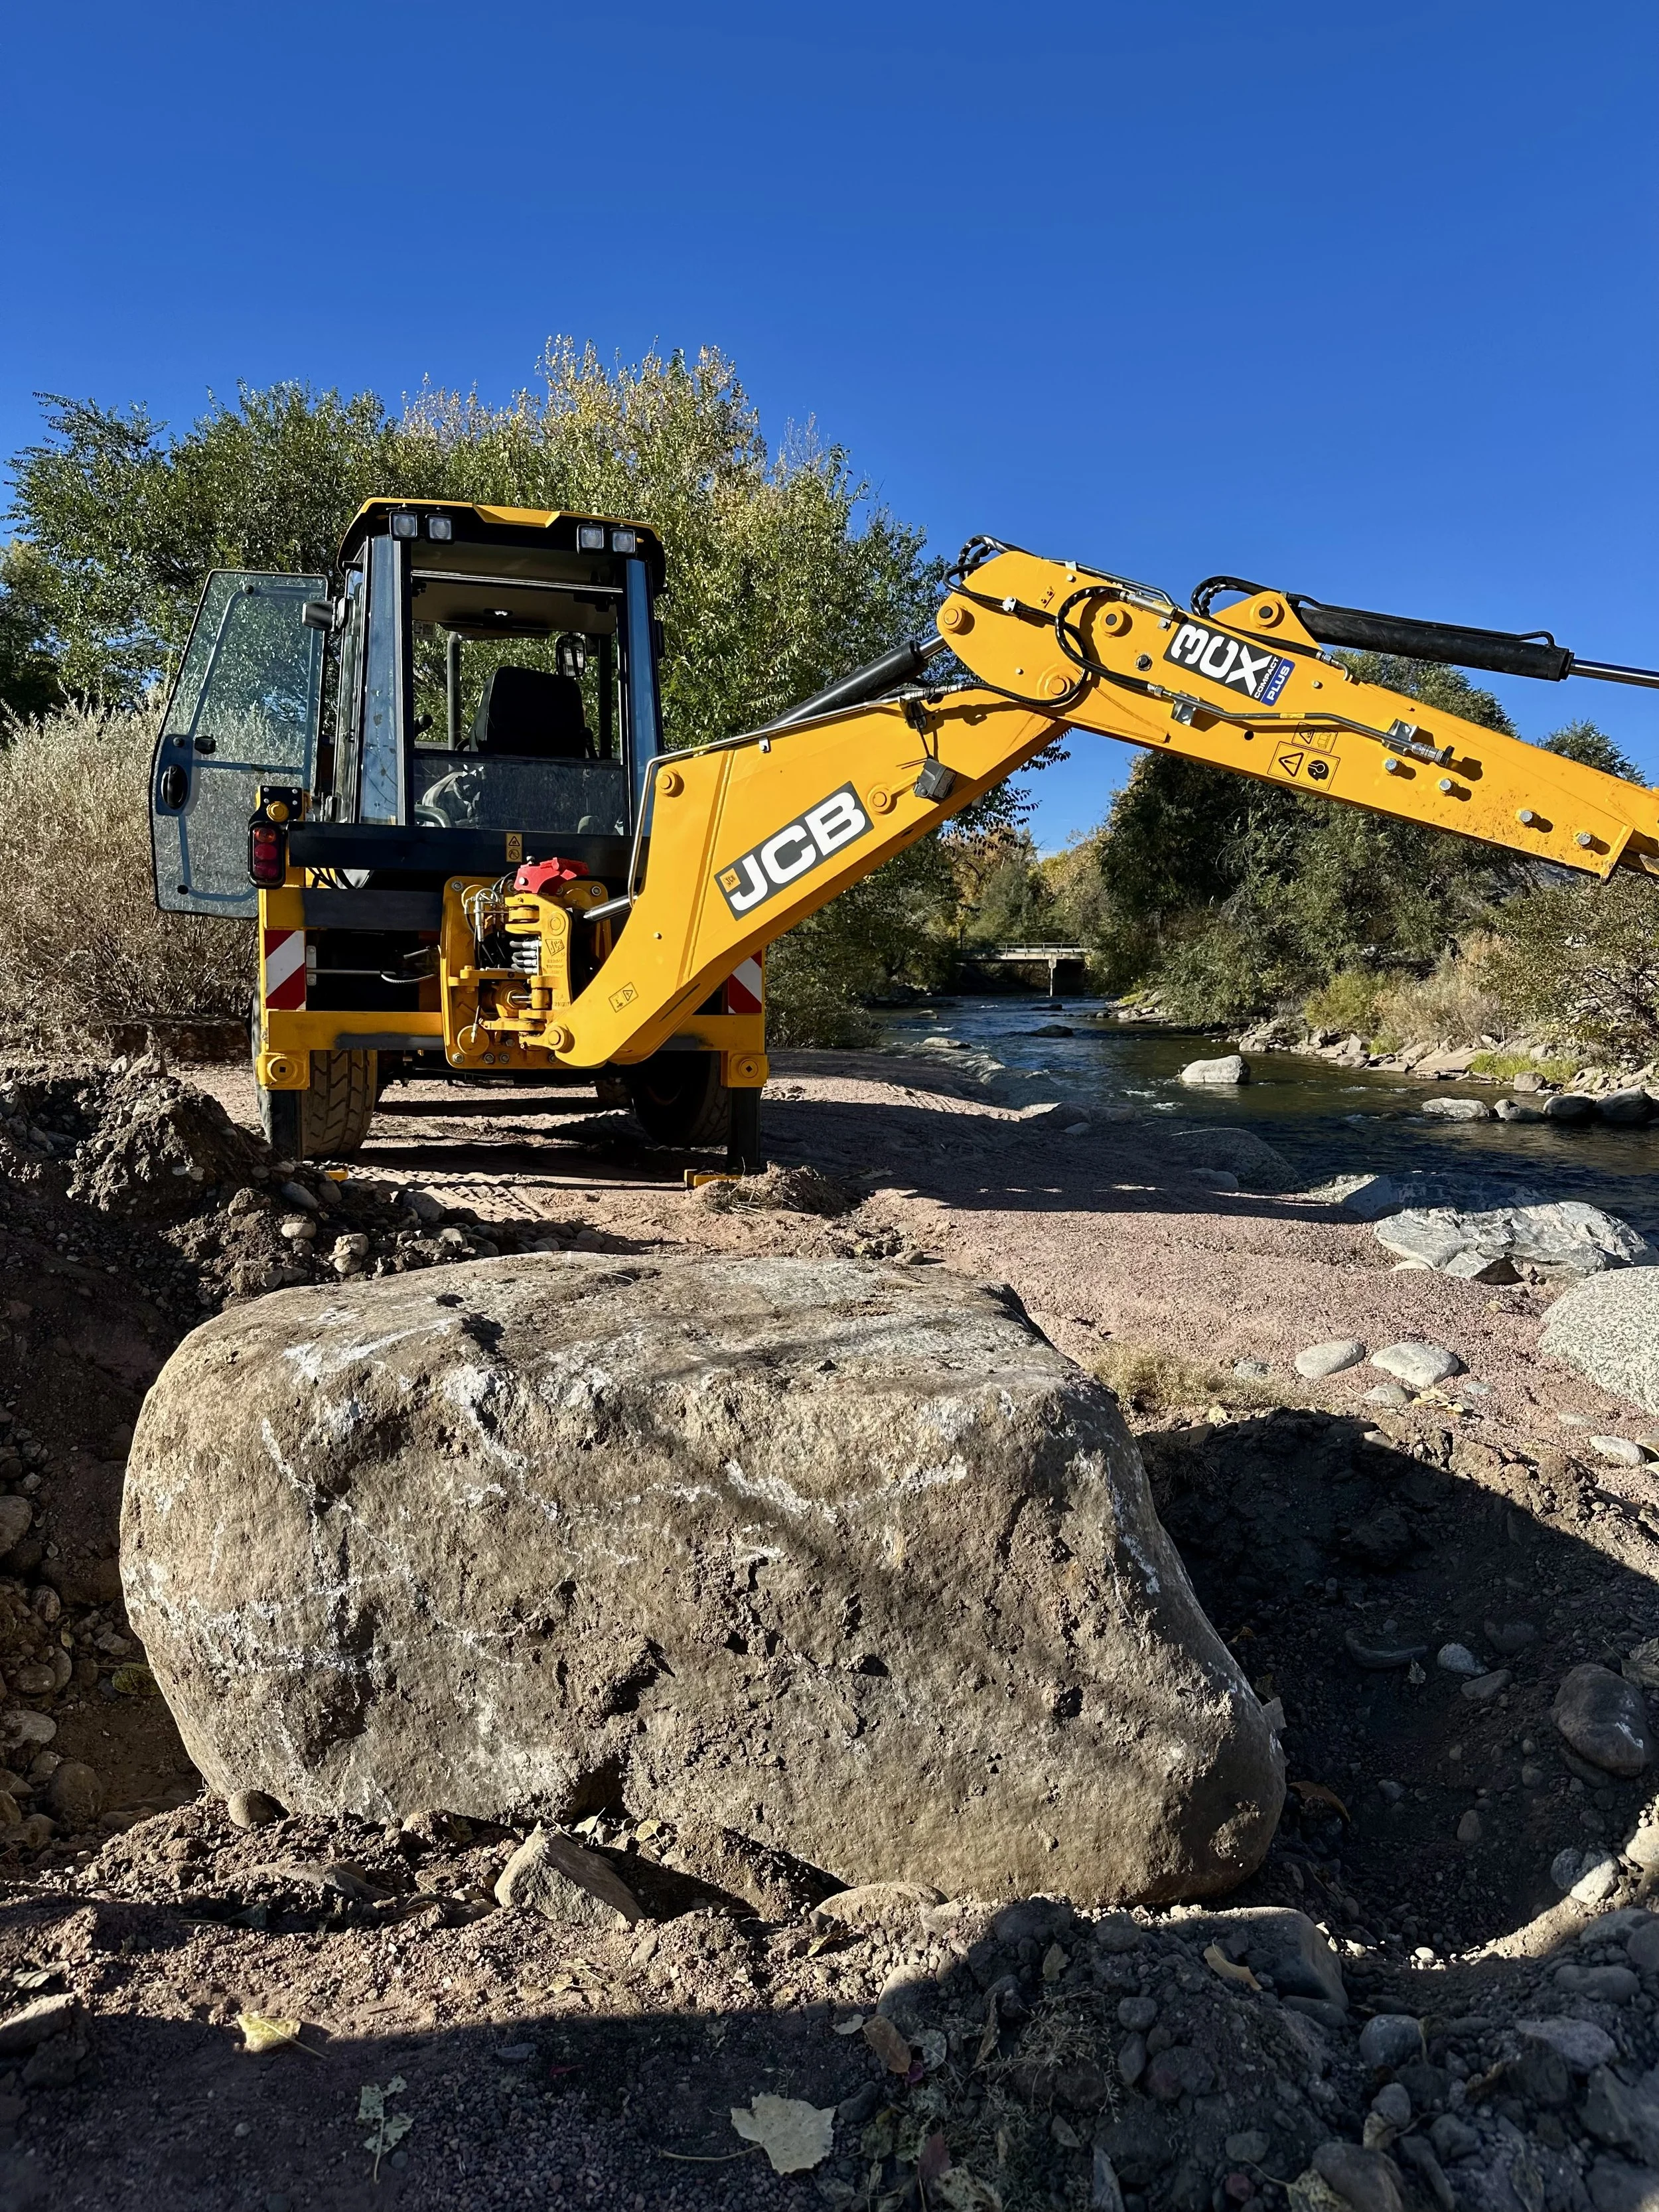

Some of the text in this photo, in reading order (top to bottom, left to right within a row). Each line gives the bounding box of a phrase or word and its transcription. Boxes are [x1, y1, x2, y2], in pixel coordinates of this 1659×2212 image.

[1254, 656, 1279, 699] COMPACT
[1267, 666, 1290, 701] PLUS
[729, 792, 866, 911] JCB
